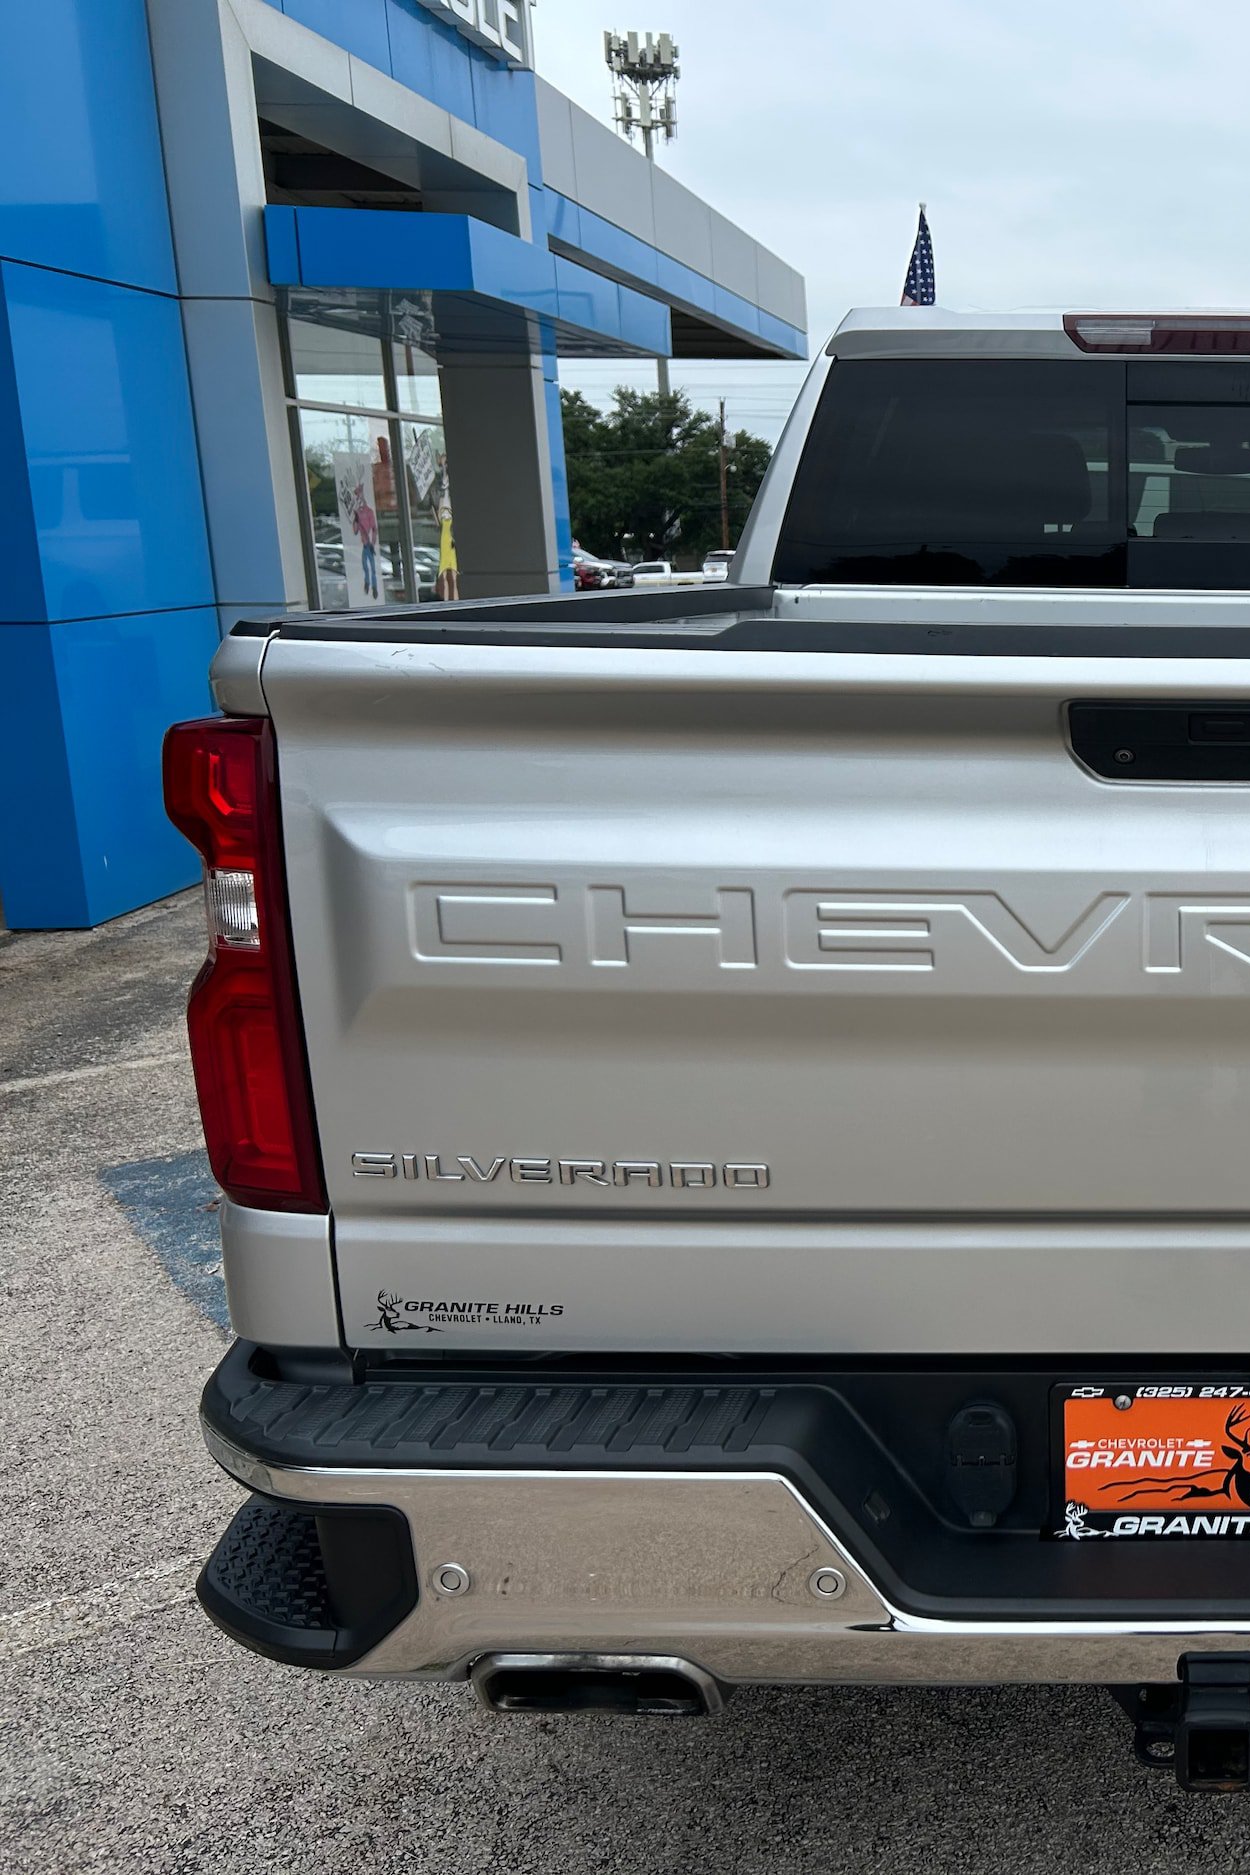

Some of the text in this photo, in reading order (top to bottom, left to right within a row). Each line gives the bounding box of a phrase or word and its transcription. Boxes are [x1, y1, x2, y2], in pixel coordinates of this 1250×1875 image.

[351, 1152, 771, 1188] SILVERADO
[404, 1301, 564, 1316] GRANITE HILLS
[428, 1313, 482, 1323] CHEVROLET
[530, 1316, 541, 1324] TX
[1136, 1386, 1193, 1398] (325)
[1097, 1438, 1184, 1449] CHEVROLET
[1066, 1450, 1215, 1468] GRANITE
